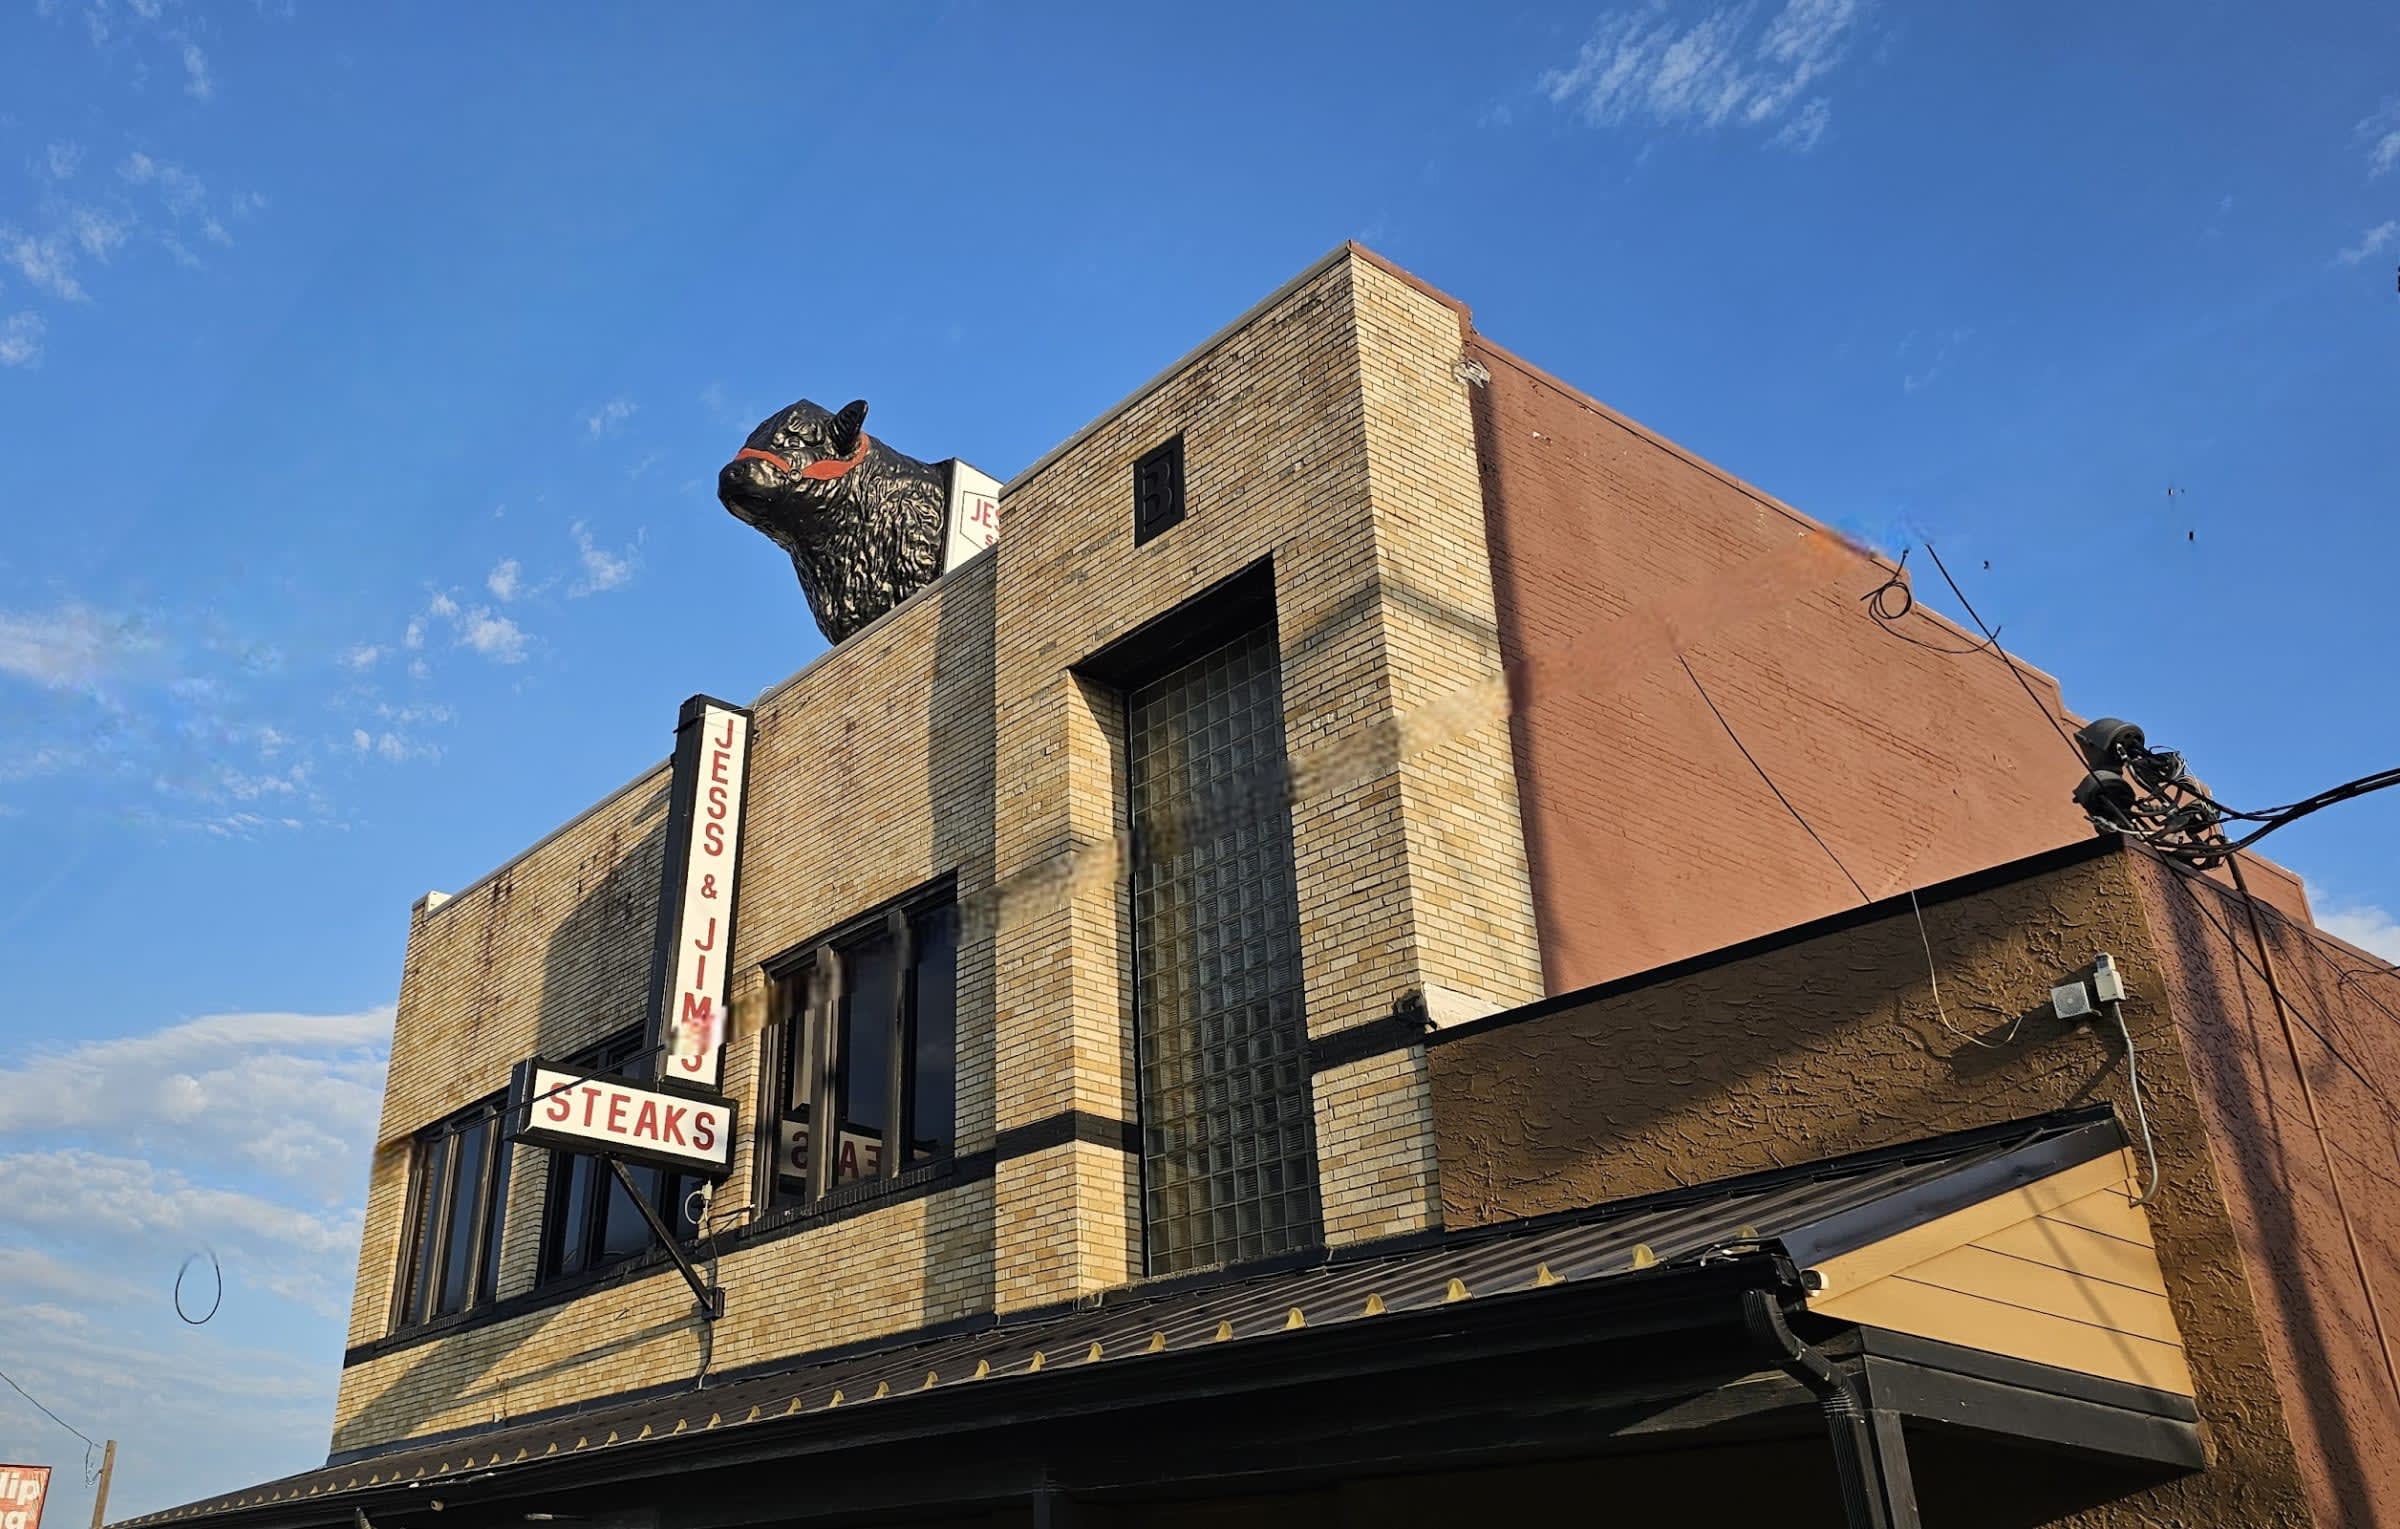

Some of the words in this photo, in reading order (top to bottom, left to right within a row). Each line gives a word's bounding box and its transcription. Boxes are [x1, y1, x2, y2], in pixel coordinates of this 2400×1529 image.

[703, 719, 734, 857] JESS
[701, 874, 718, 900] &
[546, 1082, 716, 1151] STEAKS
